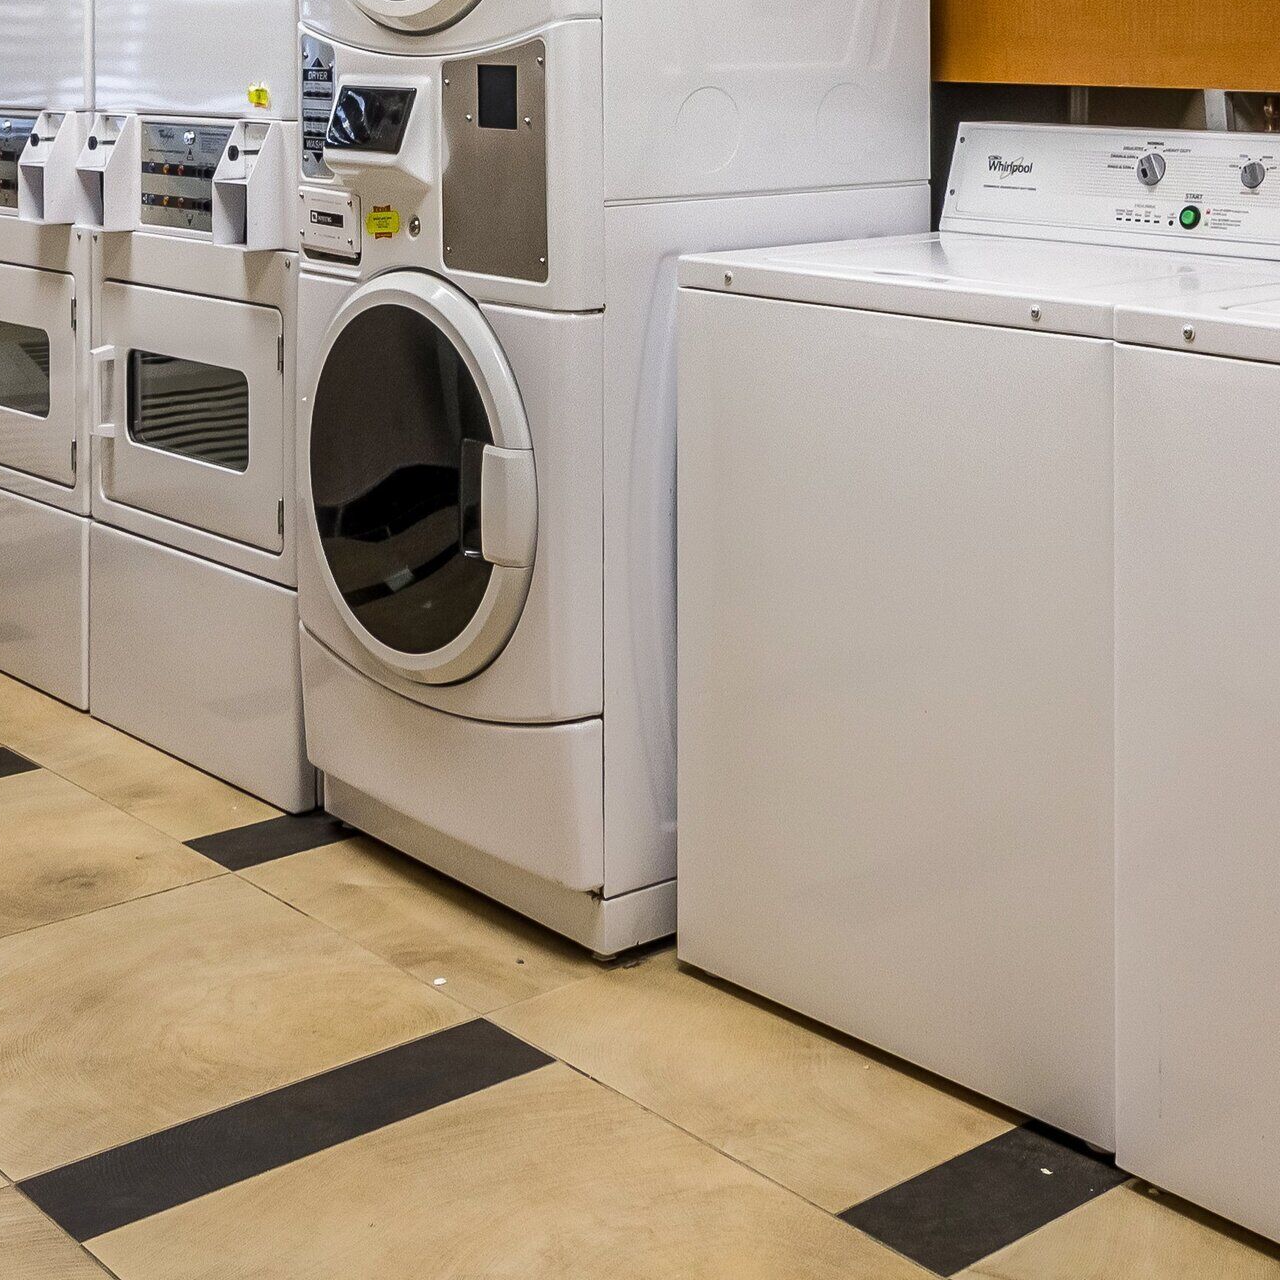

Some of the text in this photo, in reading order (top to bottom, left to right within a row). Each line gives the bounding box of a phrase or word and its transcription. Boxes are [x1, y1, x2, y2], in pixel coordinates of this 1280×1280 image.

[307, 71, 328, 80] DRYER
[306, 140, 325, 149] WASH
[988, 160, 1033, 175] Whirlpool
